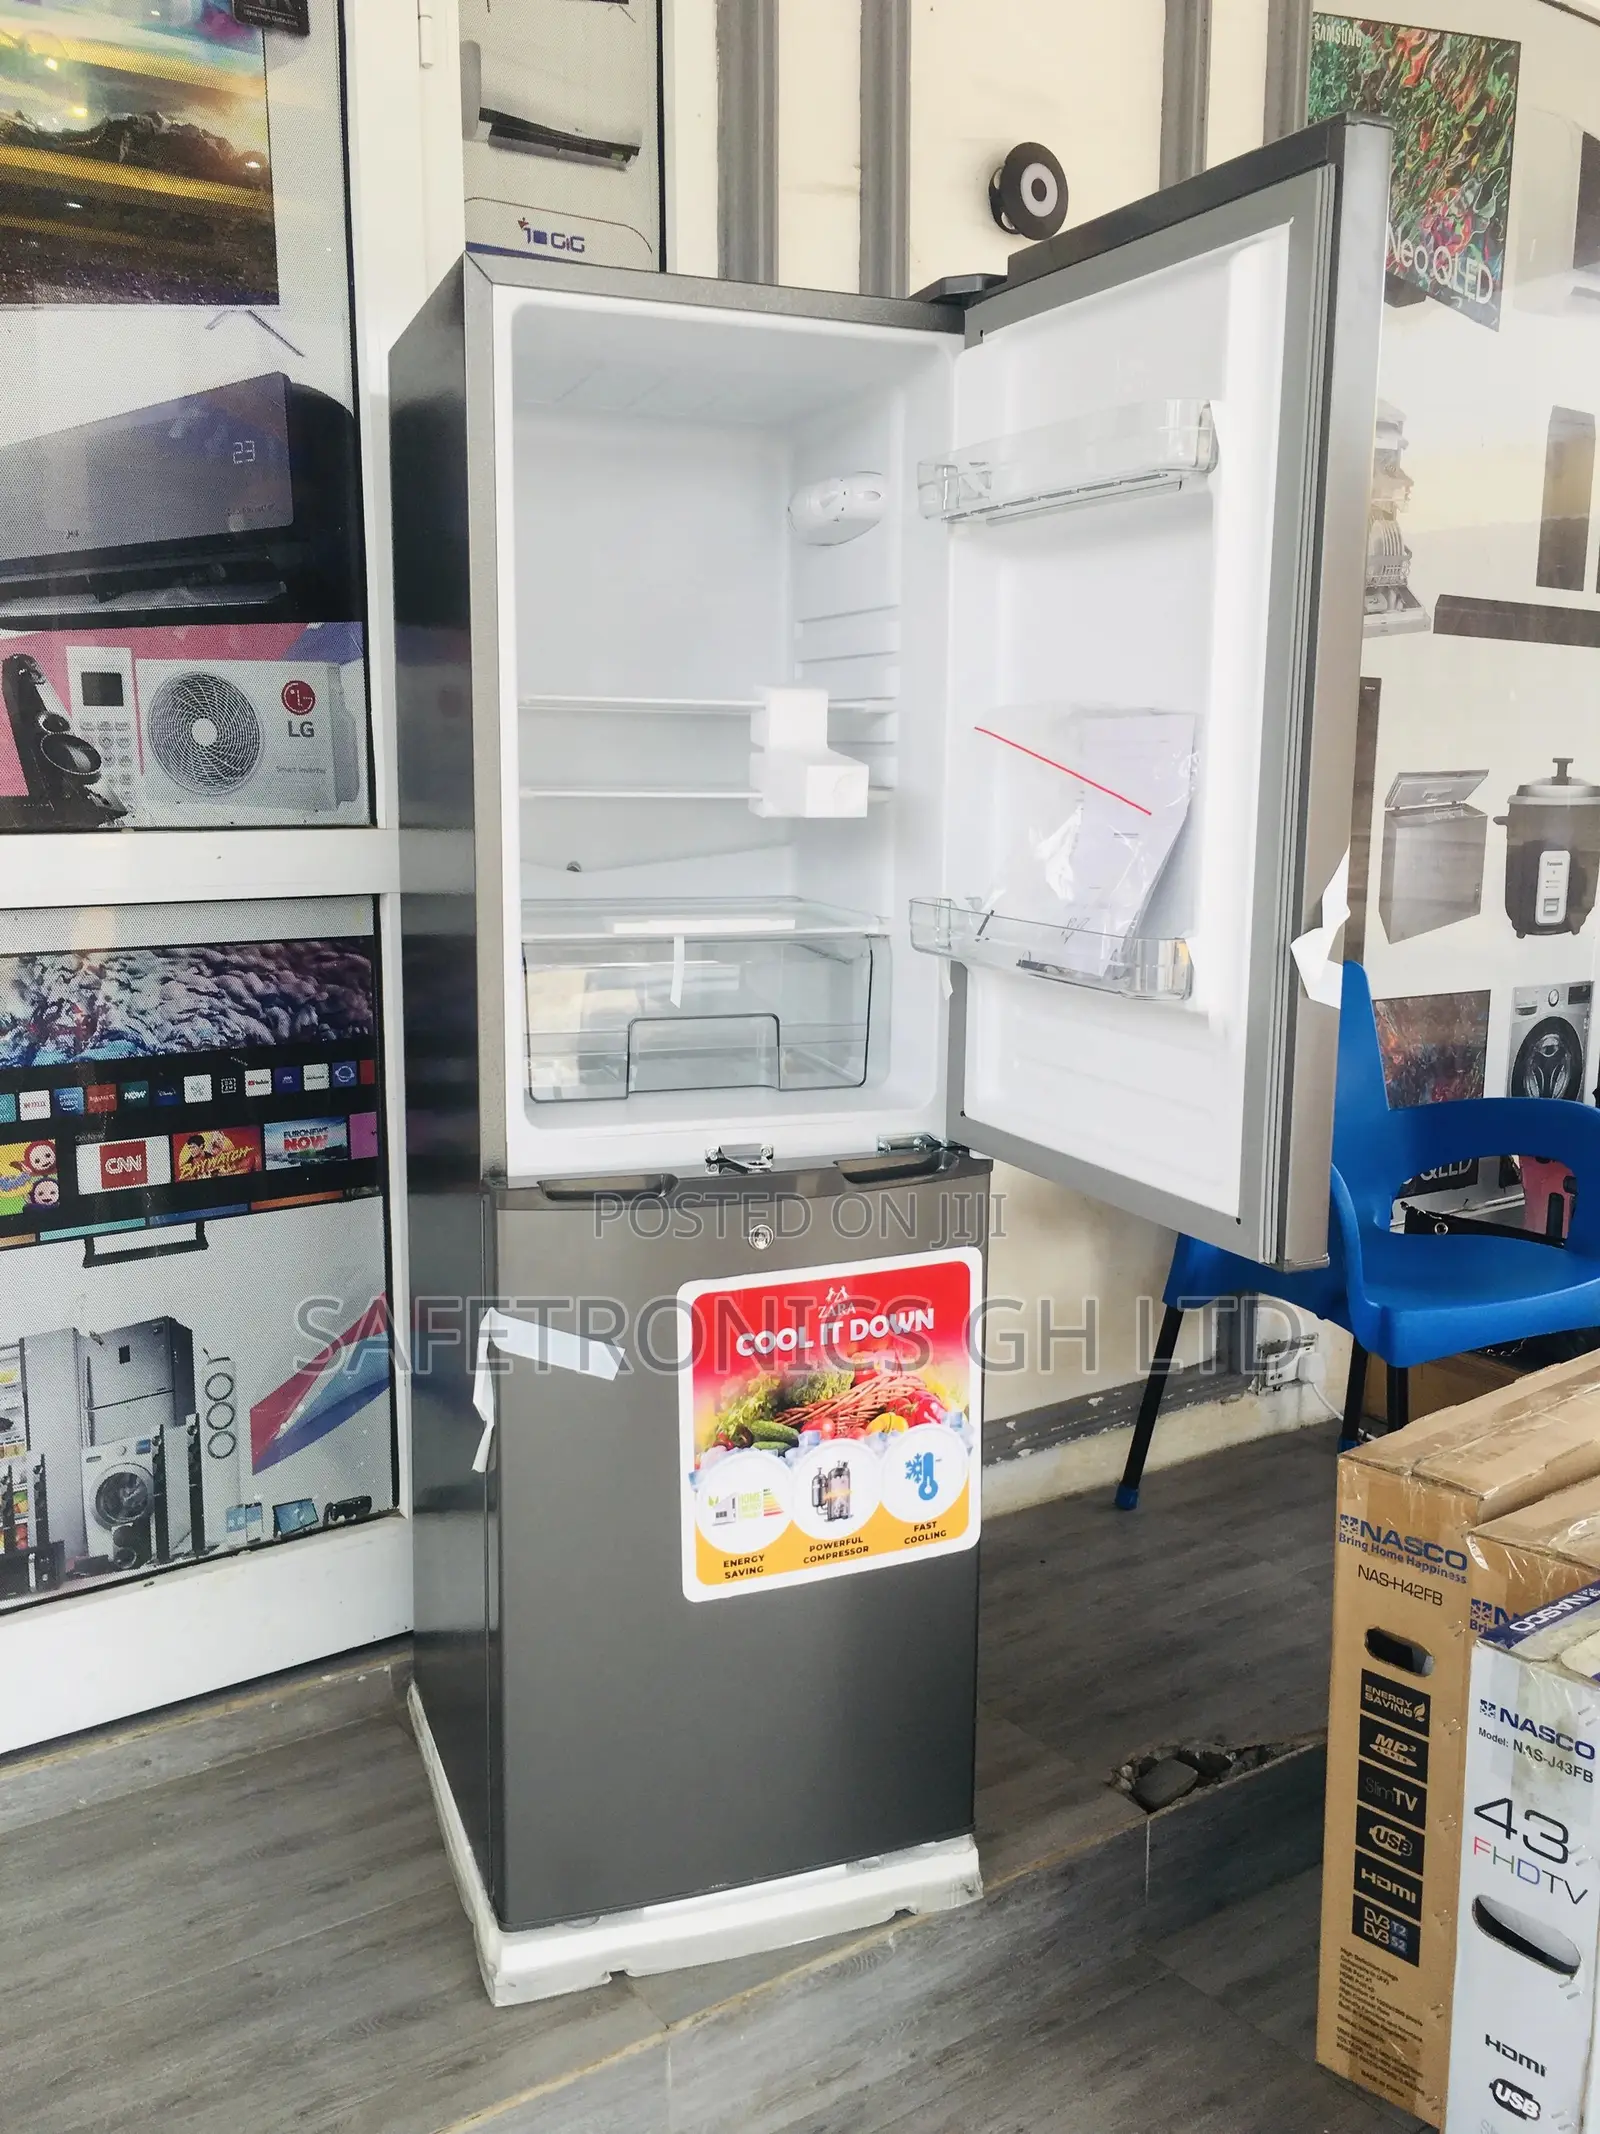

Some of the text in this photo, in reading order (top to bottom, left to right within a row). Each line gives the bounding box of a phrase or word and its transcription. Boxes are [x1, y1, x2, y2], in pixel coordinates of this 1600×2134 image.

[1315, 22, 1361, 47] SAMSUNG
[1387, 222, 1493, 304] Neo QLED
[232, 440, 256, 464] 23
[287, 720, 315, 738] LG
[124, 1090, 147, 1101] NOW
[283, 1135, 329, 1151] NOW
[105, 1154, 142, 1175] CNN
[180, 1146, 254, 1178] BAYWATCH
[818, 1301, 856, 1319] ZARA
[736, 1308, 934, 1357] COOL IT DOWN
[904, 1530, 947, 1545] COOLING
[913, 1521, 938, 1532] FAST
[803, 1545, 869, 1564] COMPRESSOR
[809, 1536, 864, 1552] POWERFUL
[1360, 1520, 1468, 1571] NASCO
[723, 1554, 765, 1568] ENERGY
[1339, 1532, 1467, 1584] Bring Home Happiness
[724, 1565, 764, 1579] SAVING
[1358, 1564, 1443, 1606] NAS-H42FB
[1509, 1594, 1593, 1632] NASCO
[1364, 1684, 1413, 1709] ENERGY
[1364, 1692, 1413, 1718] SAVING
[1500, 1707, 1595, 1760] NASCO
[1478, 1727, 1594, 1784] Model: NAS-J43FB
[1375, 1827, 1412, 1856] USB
[1474, 1797, 1569, 1865] 43
[1473, 1836, 1588, 1905] FHDTV
[1361, 1867, 1417, 1904] HDMI
[1364, 1906, 1390, 1931] DVB
[1363, 1920, 1389, 1945] DVB
[1485, 2033, 1546, 2078] HDMI
[1495, 2082, 1540, 2120] USB
